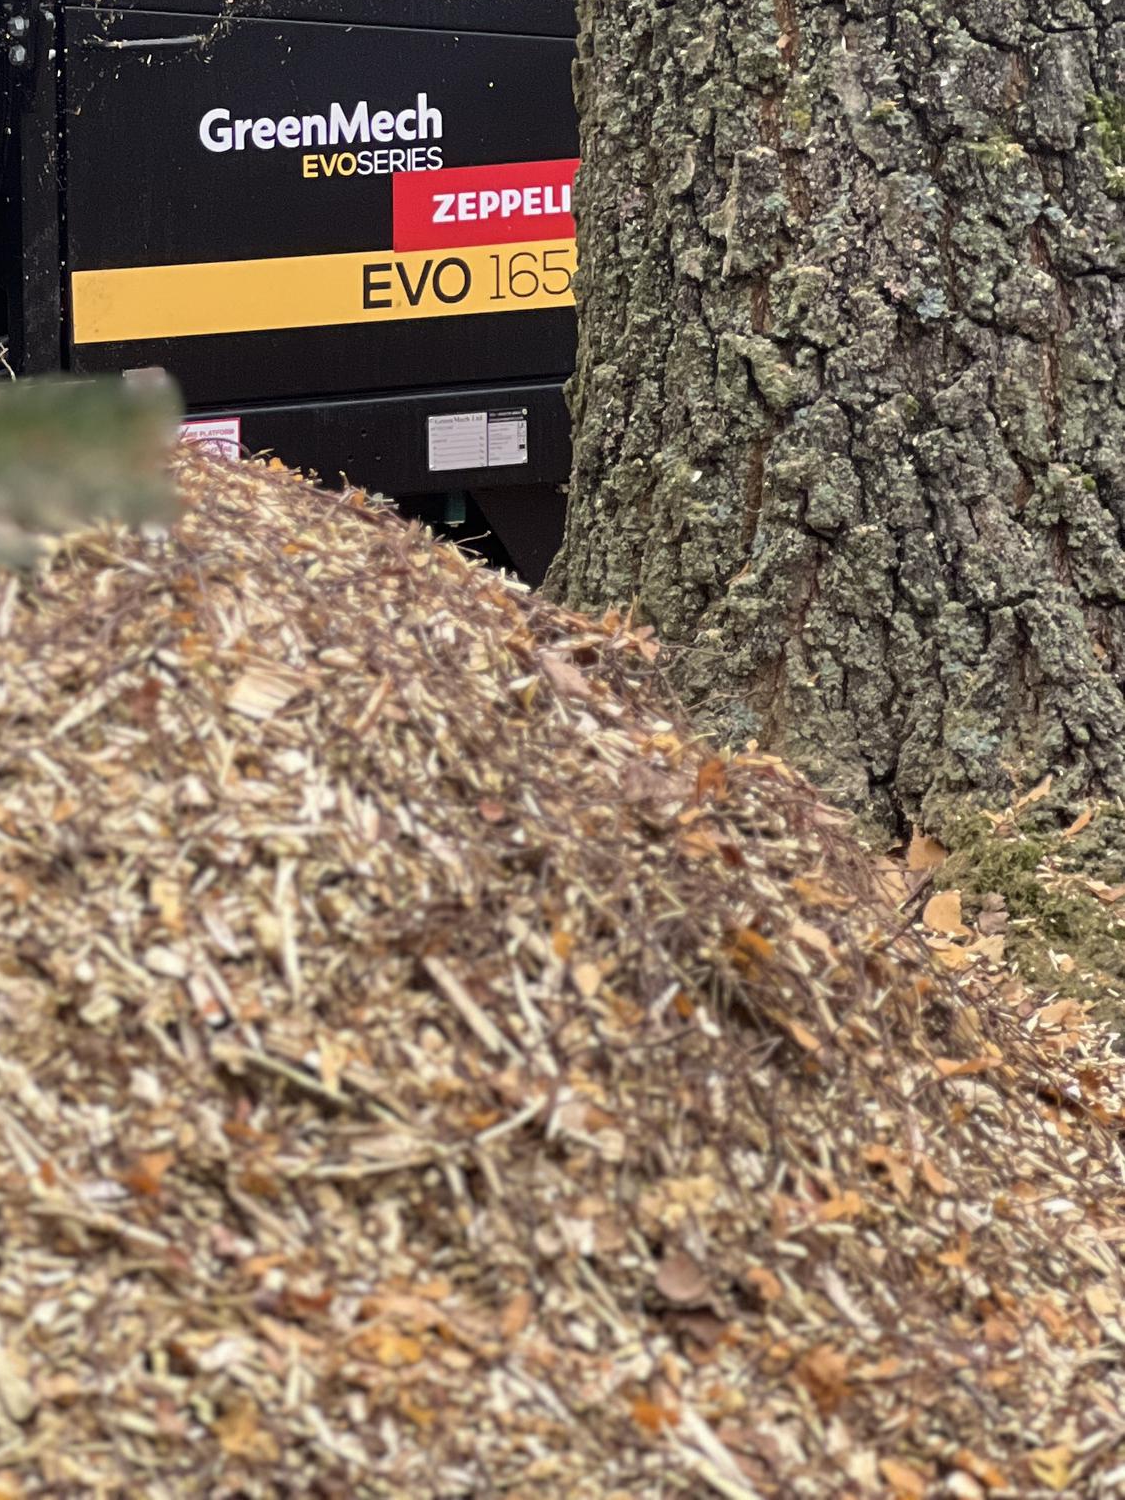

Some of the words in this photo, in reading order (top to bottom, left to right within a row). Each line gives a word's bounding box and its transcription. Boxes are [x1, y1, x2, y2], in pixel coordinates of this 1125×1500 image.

[199, 92, 443, 152] GreenMech
[303, 146, 444, 178] EVOSERIES
[432, 184, 572, 224] ZEPPELI
[362, 257, 472, 310] EVO
[489, 249, 572, 301] 165
